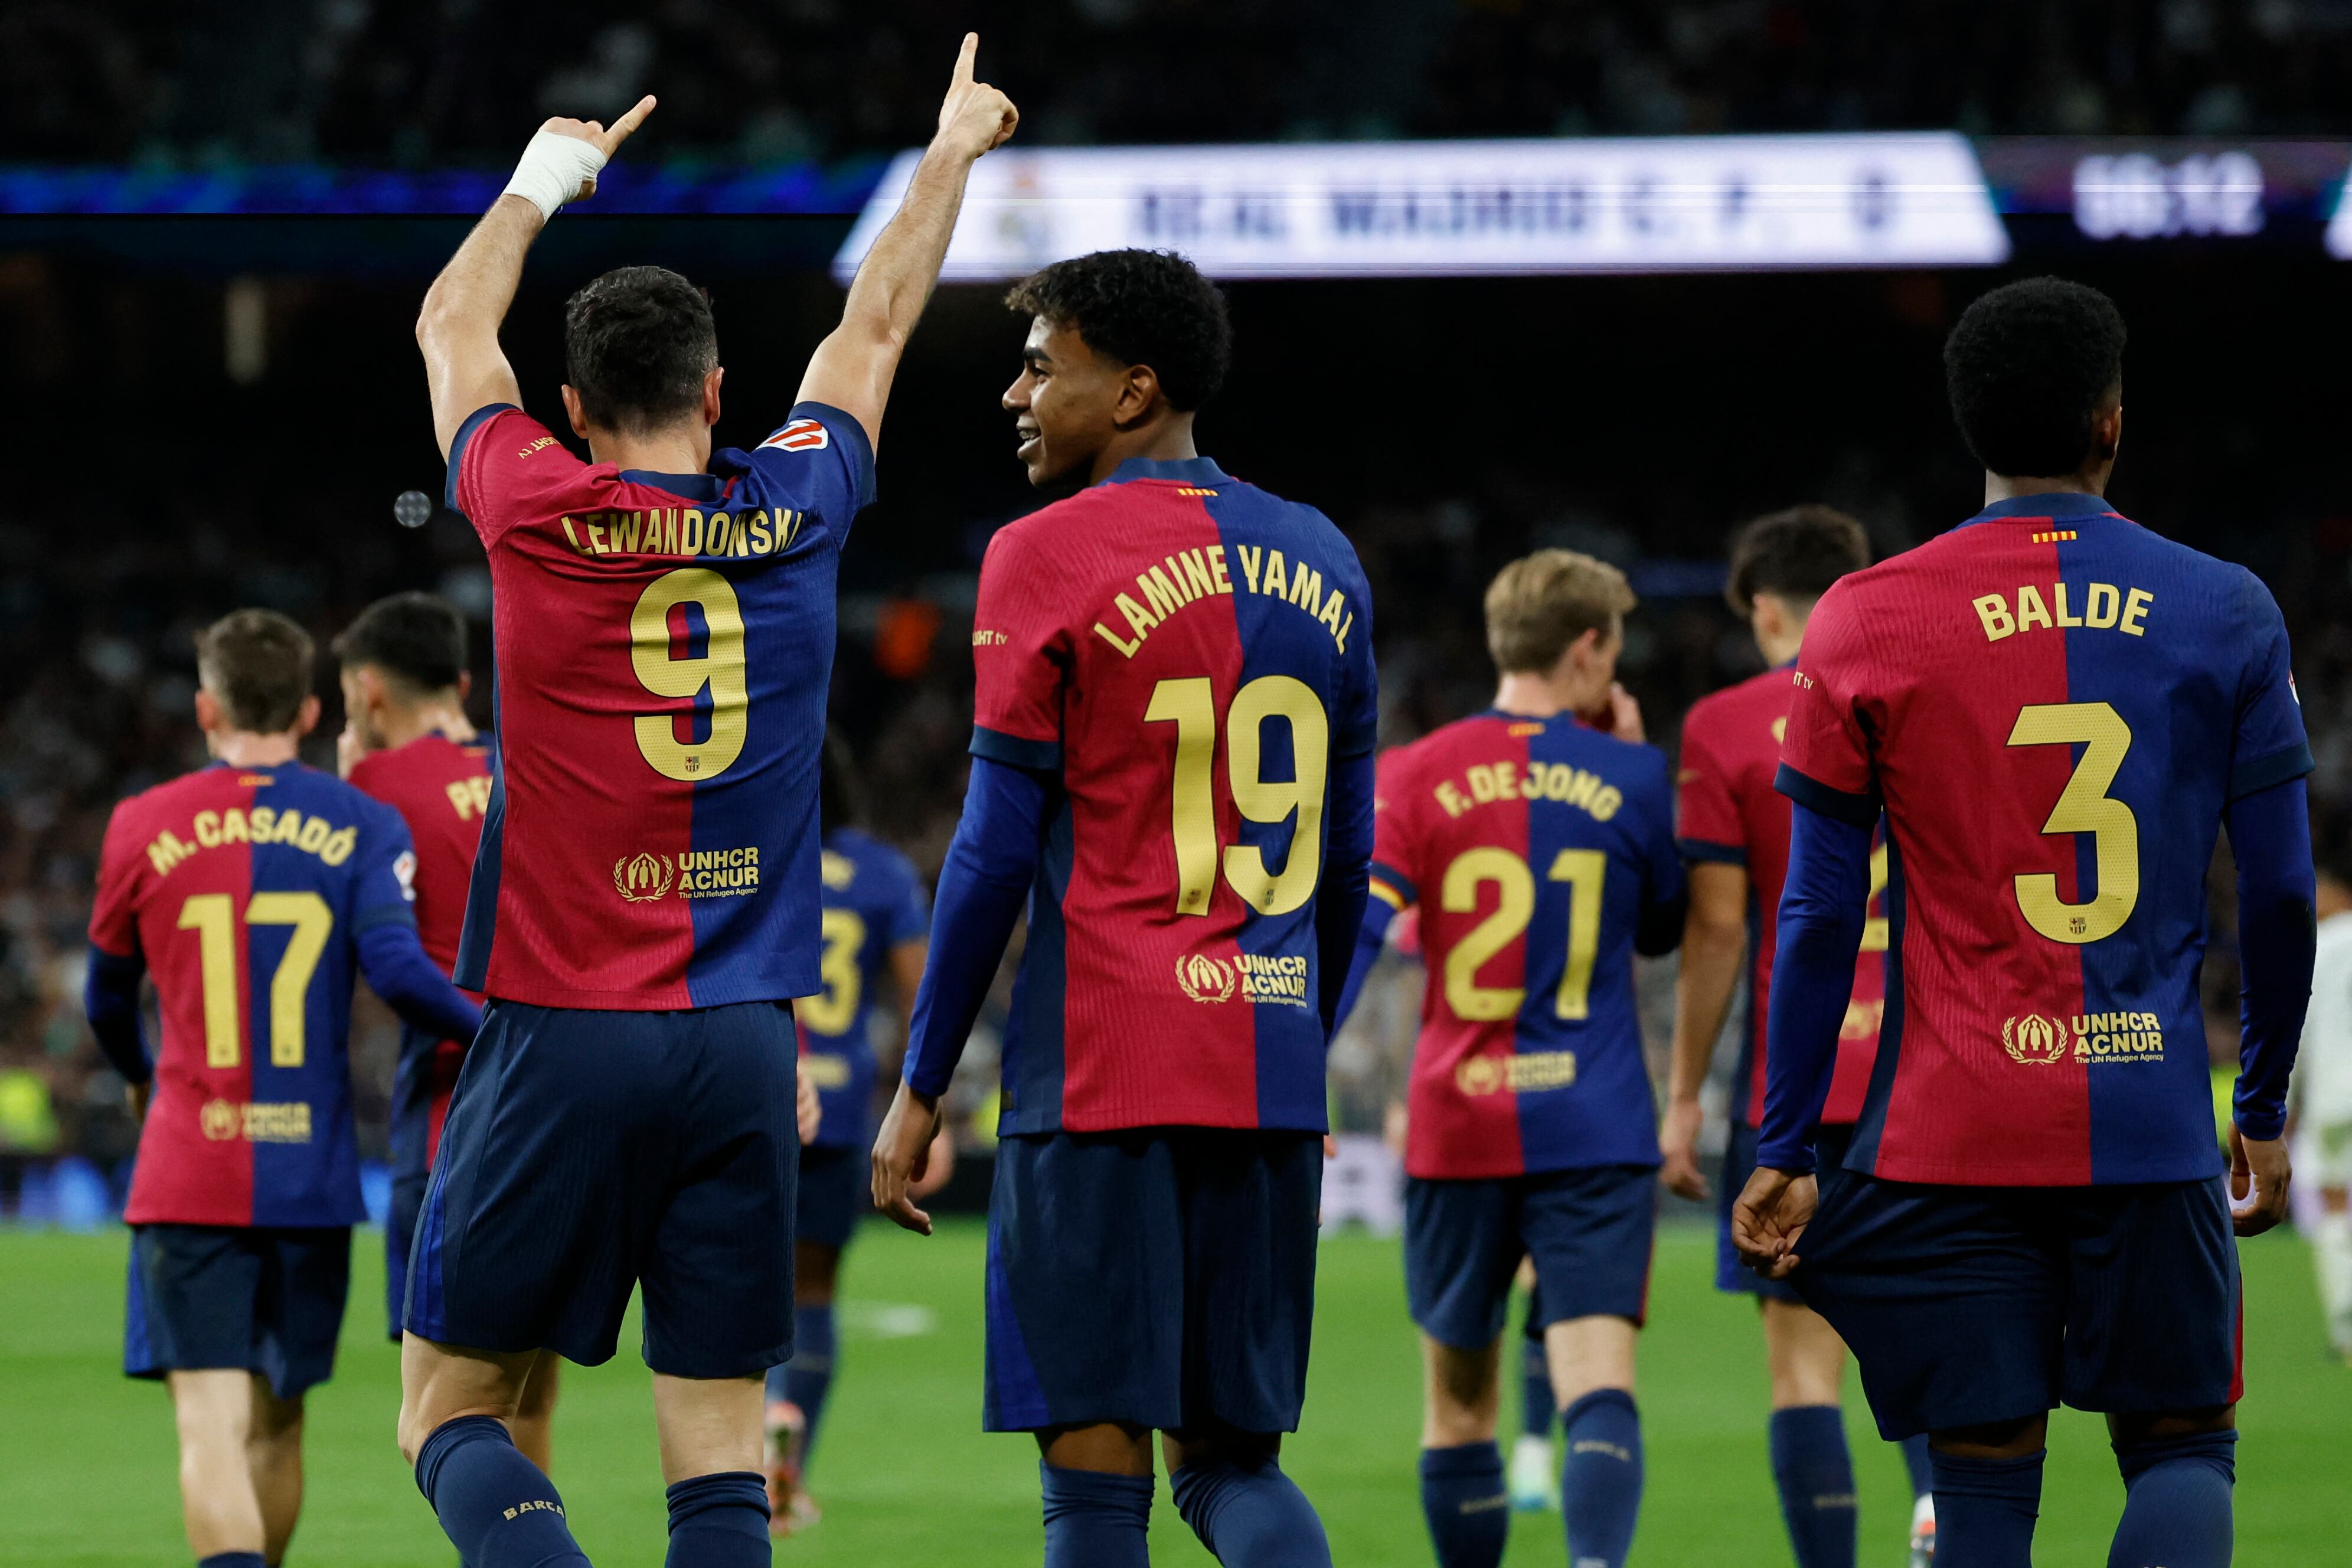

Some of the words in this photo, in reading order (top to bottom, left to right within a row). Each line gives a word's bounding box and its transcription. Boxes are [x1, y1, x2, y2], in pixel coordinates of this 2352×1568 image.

[1093, 544, 1234, 659] LAMINE
[1237, 544, 1354, 656] YAMAL
[1972, 582, 2154, 642] BALDE
[630, 567, 749, 781] 9
[445, 776, 494, 821] PE
[1143, 675, 1329, 917] 19
[1434, 778, 1474, 819] F.
[1466, 760, 1519, 804] DE
[1520, 762, 1622, 822] JONG
[146, 829, 198, 877] M.
[193, 806, 357, 867] CASADÓ
[2006, 701, 2139, 944] 3
[678, 867, 759, 890] ACNUR
[679, 847, 759, 870] UNHCR
[678, 891, 692, 900] The
[706, 890, 734, 899] Refugee
[736, 887, 758, 896] Agency
[1442, 846, 1607, 1021] 21
[177, 892, 334, 1069] 17
[1233, 953, 1307, 977] UNHCR
[1242, 974, 1306, 998] ACNUR
[2072, 1011, 2161, 1035] UNHCR
[2073, 1031, 2164, 1055] ACNUR
[2105, 1054, 2139, 1063] Refugee
[2140, 1053, 2164, 1062] Agency
